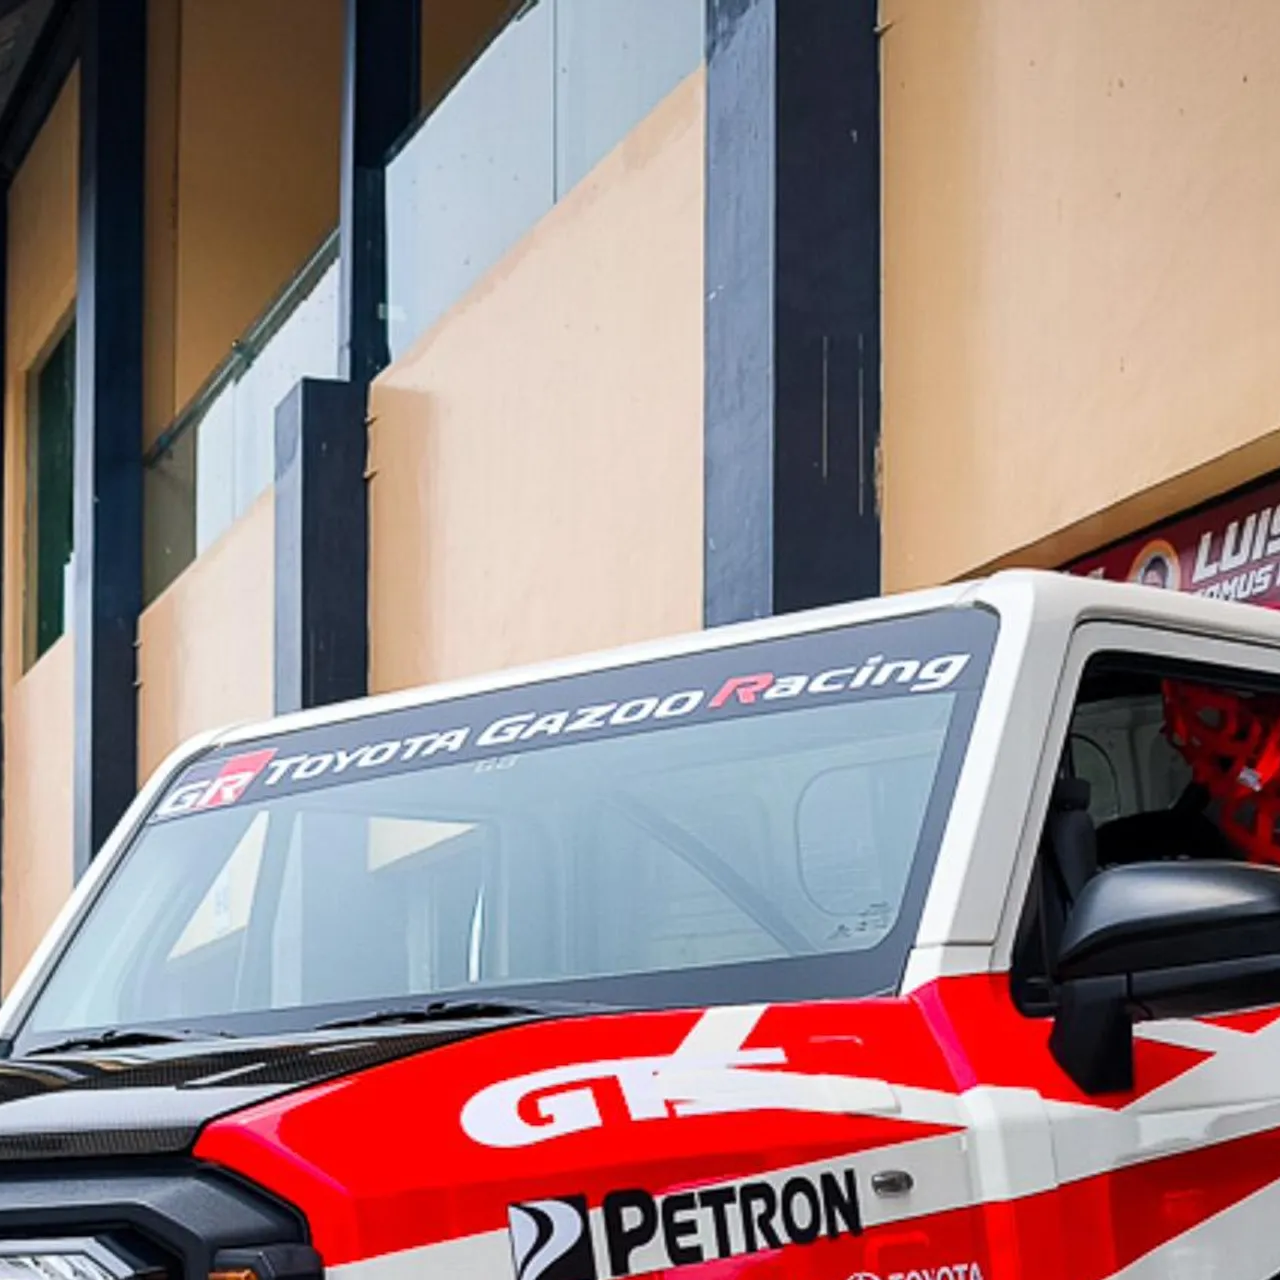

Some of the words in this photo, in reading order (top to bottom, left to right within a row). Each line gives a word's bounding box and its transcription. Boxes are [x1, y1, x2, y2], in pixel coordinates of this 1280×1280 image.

[1194, 565, 1273, 600] AMUS
[158, 770, 254, 815] GR
[264, 727, 471, 786] TOYOTA
[475, 689, 705, 747] GAZOO
[708, 652, 971, 710] Racing
[605, 1167, 863, 1277] PETRON
